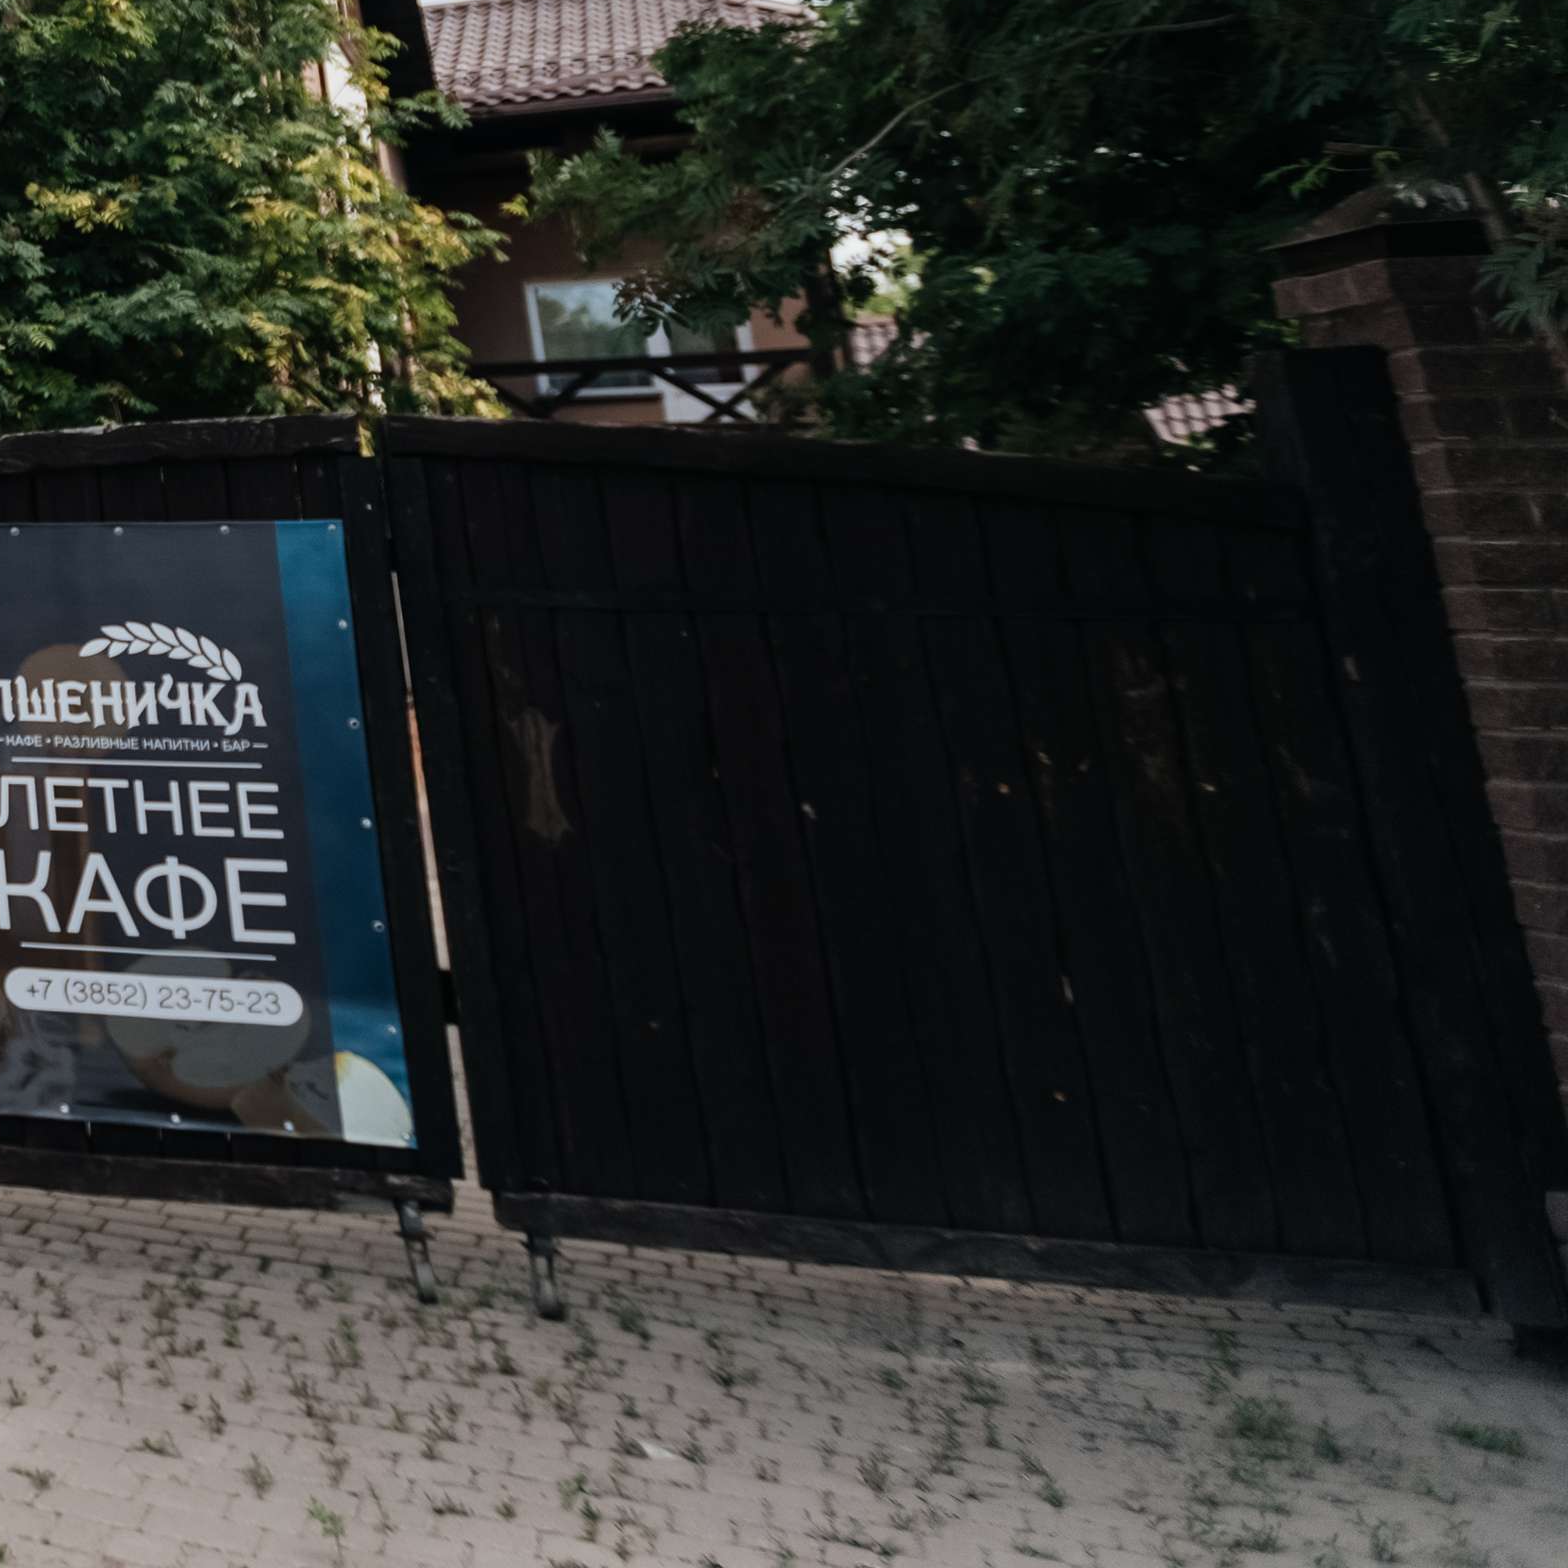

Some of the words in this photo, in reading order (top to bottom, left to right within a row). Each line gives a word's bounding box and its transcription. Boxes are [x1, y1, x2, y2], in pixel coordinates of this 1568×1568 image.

[5, 736, 43, 747] КАФЕ
[54, 737, 139, 750] РАЗЛИВНЫЕ
[143, 739, 210, 751] НАПИТКИ
[222, 740, 251, 752] БАР
[26, 979, 52, 999] +7
[64, 977, 148, 1009] (3852)
[158, 987, 282, 1015] 23-75-23
